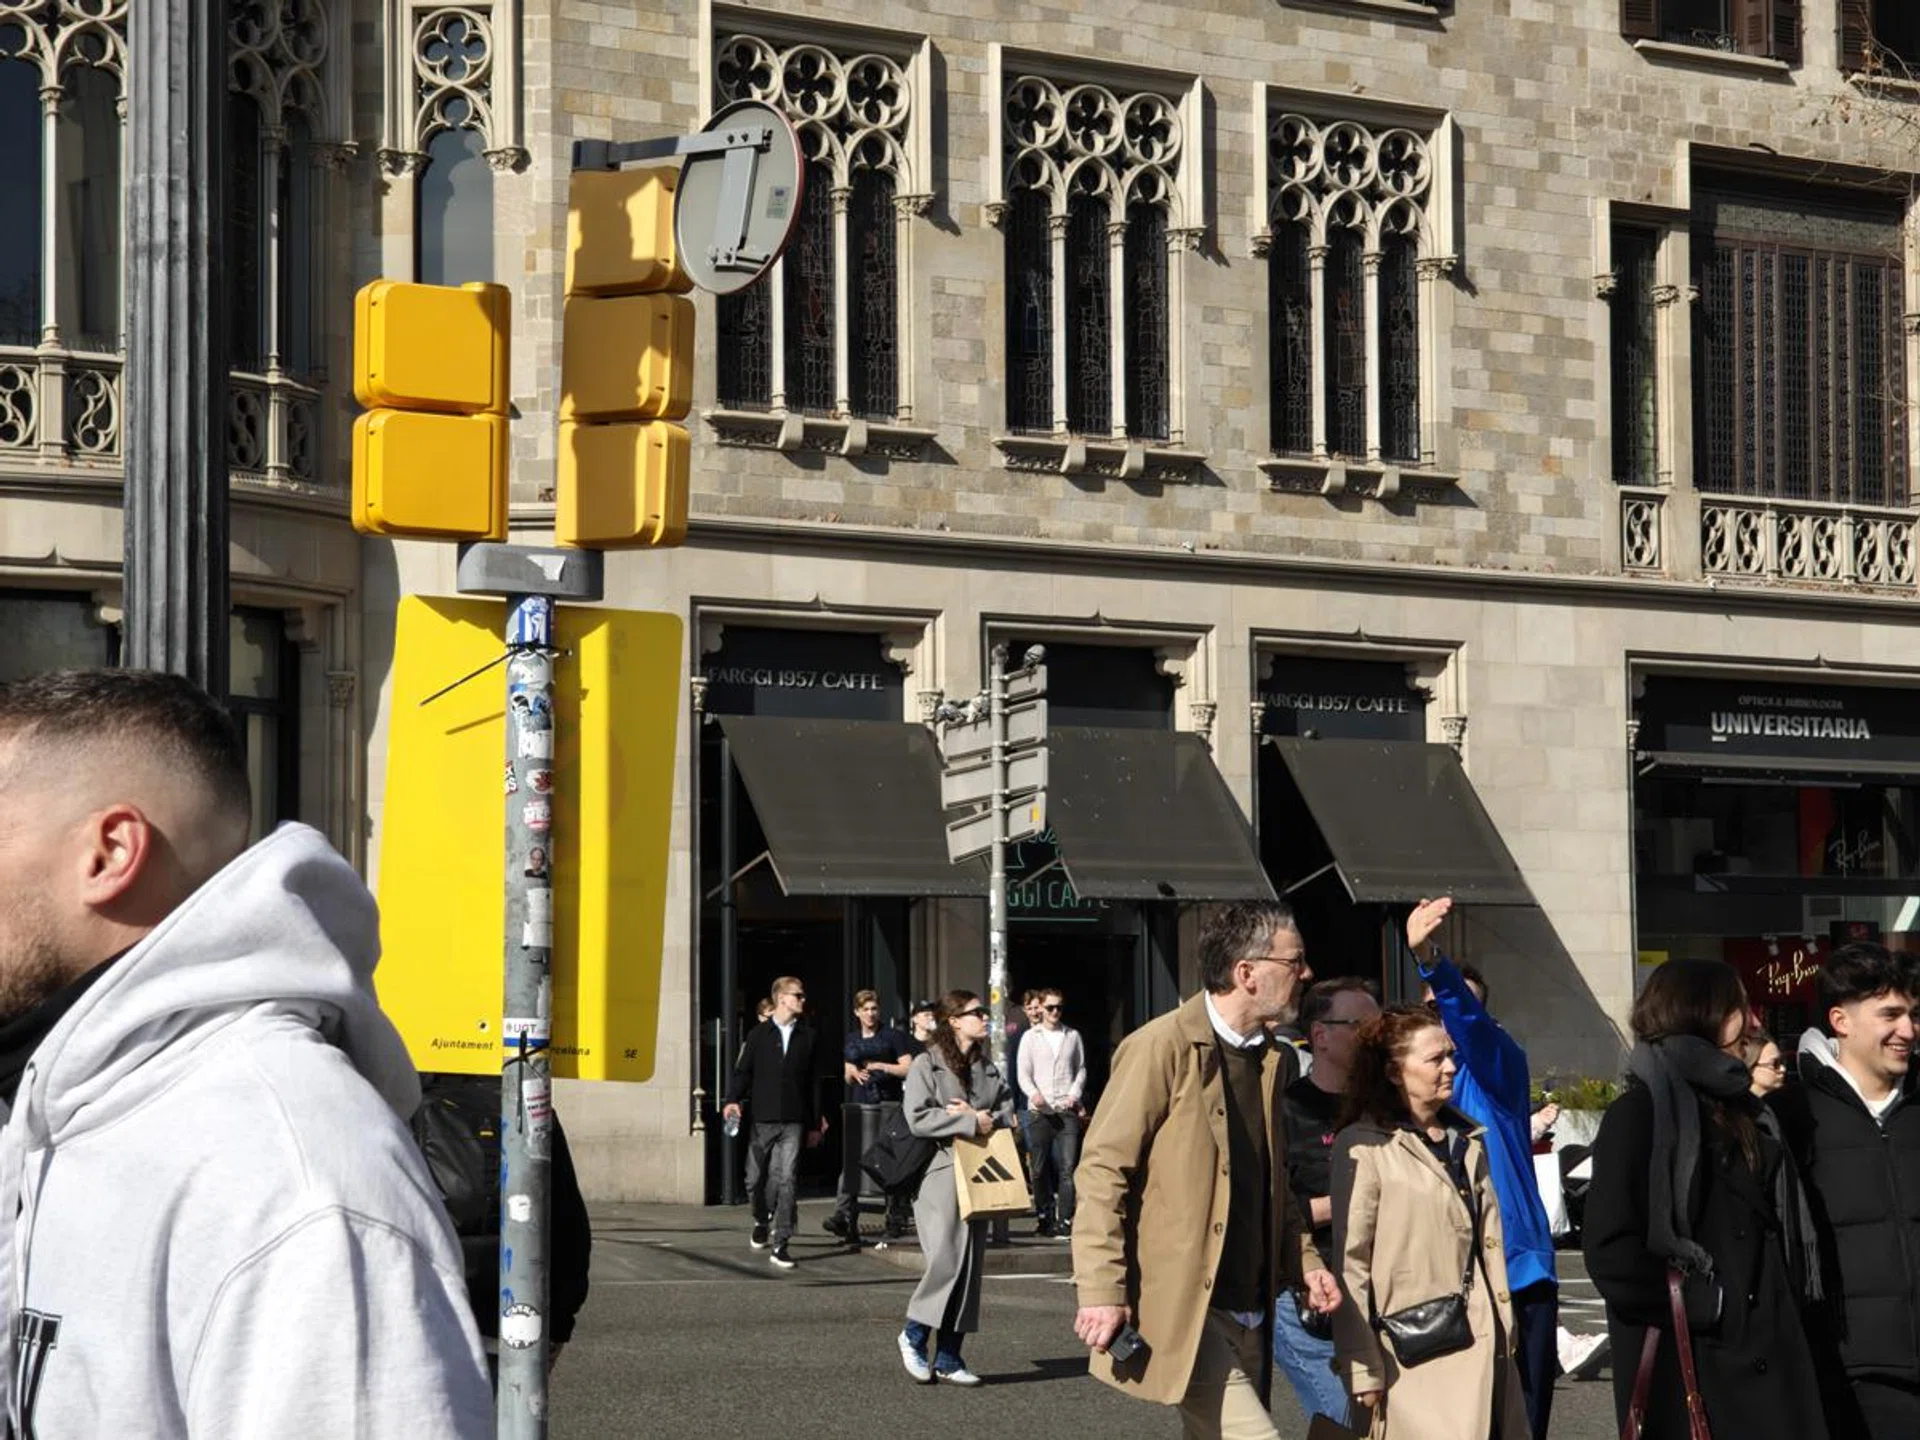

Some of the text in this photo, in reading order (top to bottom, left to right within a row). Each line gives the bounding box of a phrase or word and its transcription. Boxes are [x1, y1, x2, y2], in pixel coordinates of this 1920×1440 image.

[708, 667, 884, 690] FARGGI 1957 CAFFE
[1318, 695, 1350, 711] 1957
[1711, 712, 1871, 740] UNIVERSITARIA
[431, 1037, 494, 1051] Ajuntament
